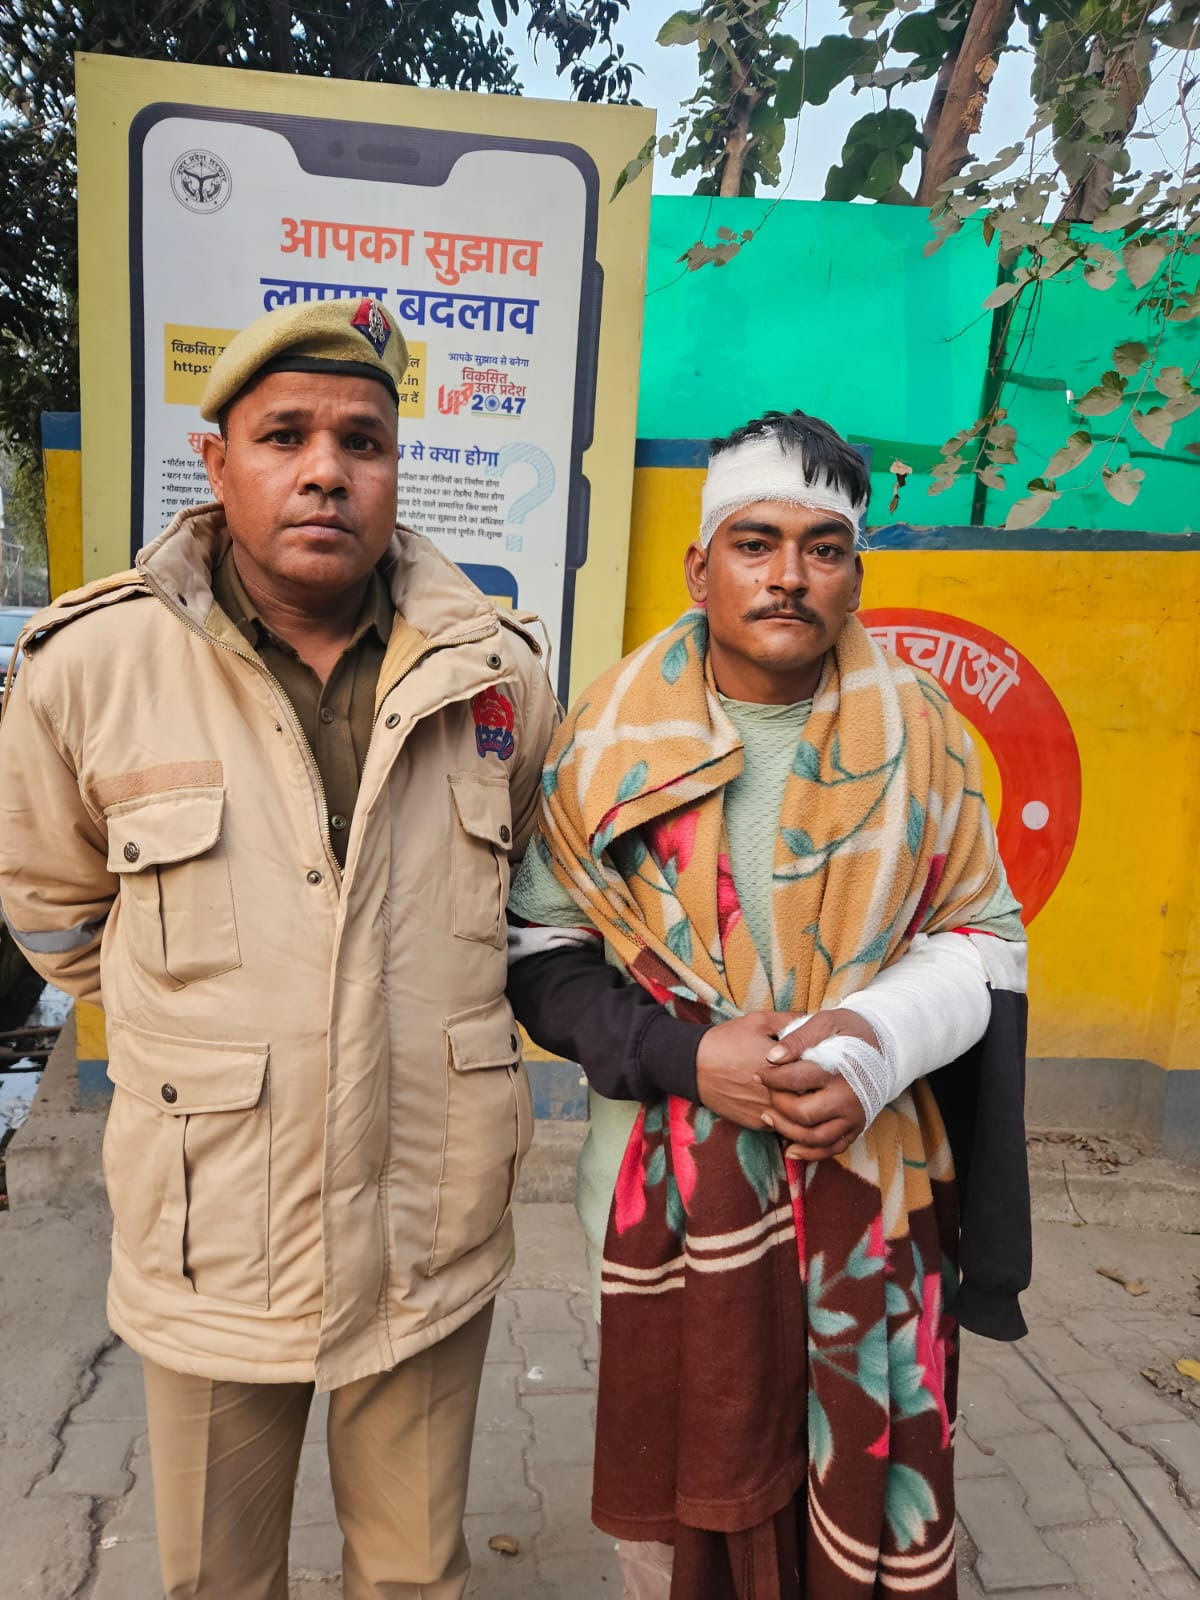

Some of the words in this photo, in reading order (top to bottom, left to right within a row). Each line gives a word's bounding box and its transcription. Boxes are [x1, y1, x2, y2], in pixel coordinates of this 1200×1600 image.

[280, 217, 415, 266] आपका
[424, 230, 544, 286] सुझाव
[397, 288, 540, 334] बदलाव
[171, 339, 216, 356] विकसित
[448, 352, 473, 362] आपके
[475, 355, 498, 366] सुझाव
[500, 354, 507, 365] से
[509, 356, 530, 368] बनेगा
[461, 366, 508, 384] विकसित
[474, 382, 497, 394] उत्तर
[500, 382, 527, 397] प्रदेश
[410, 440, 426, 461] से
[429, 445, 461, 464] क्या
[465, 445, 500, 467] होगा
